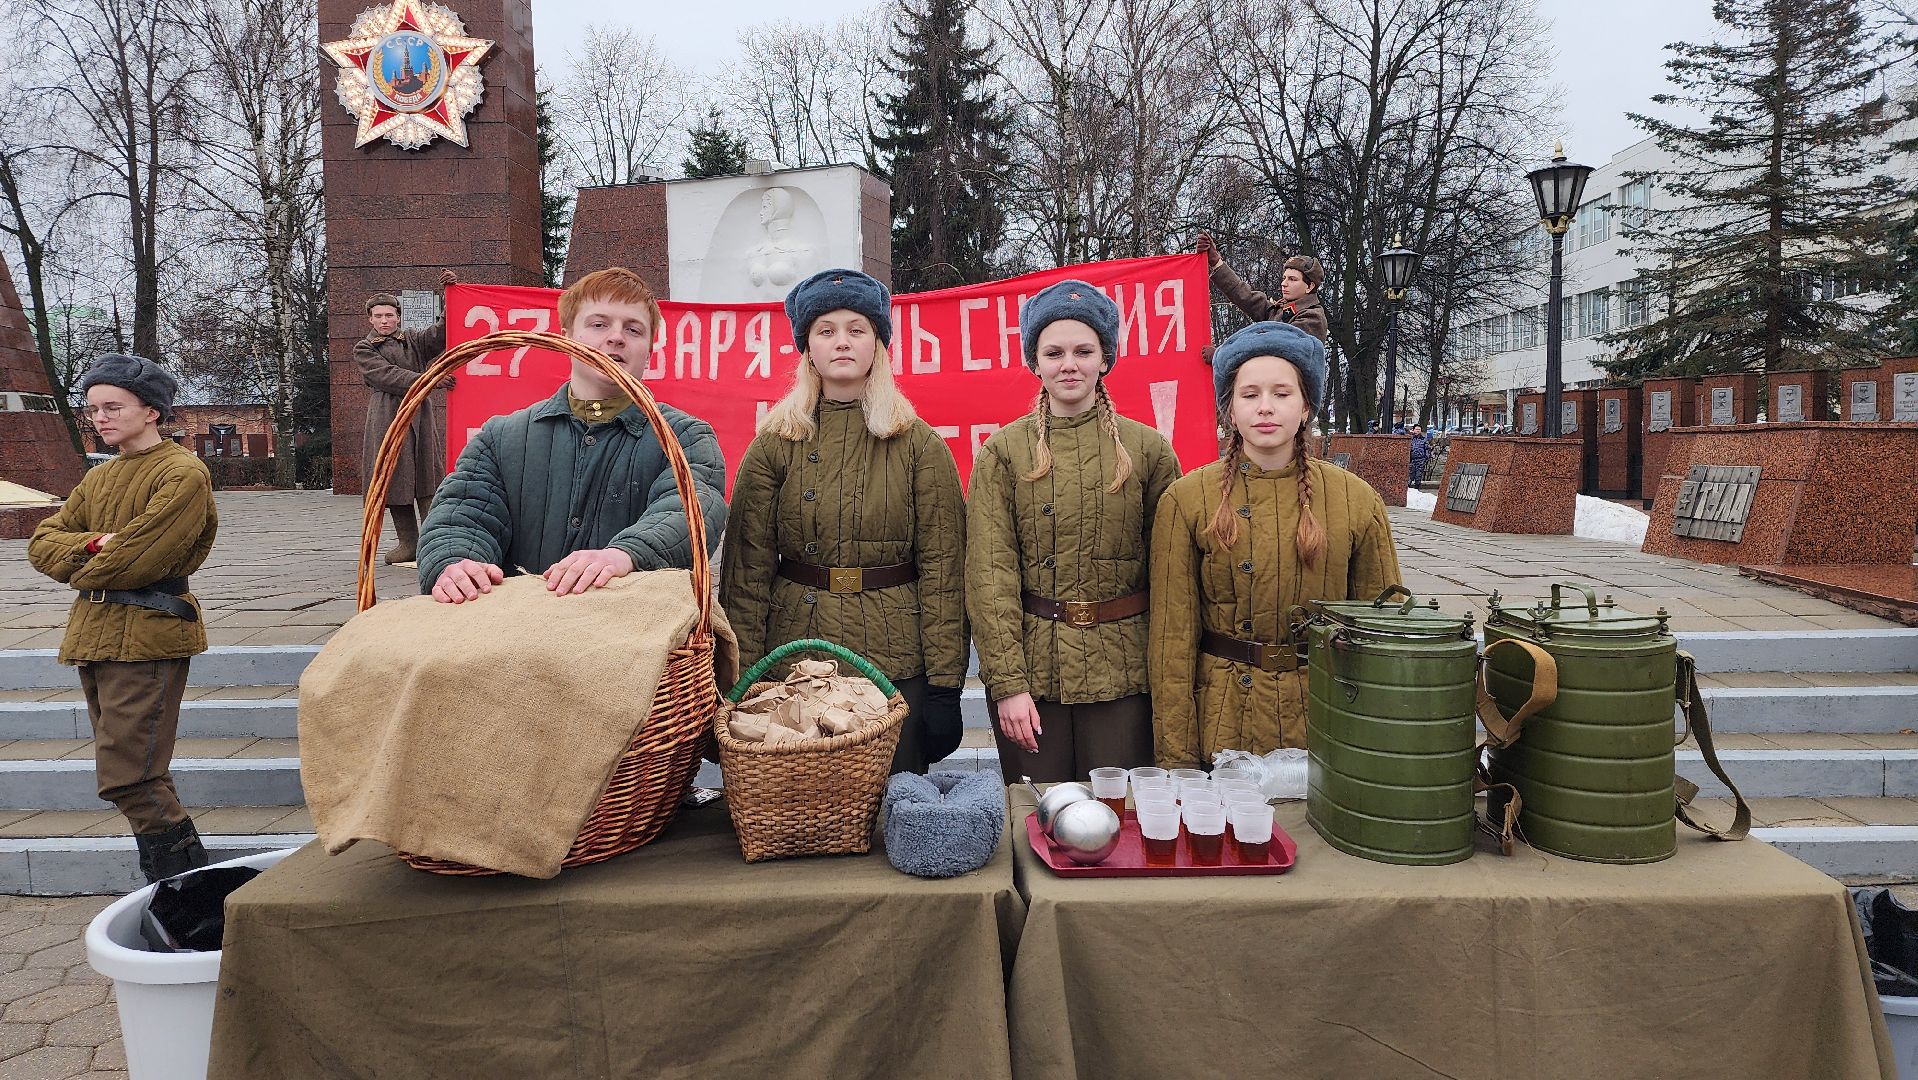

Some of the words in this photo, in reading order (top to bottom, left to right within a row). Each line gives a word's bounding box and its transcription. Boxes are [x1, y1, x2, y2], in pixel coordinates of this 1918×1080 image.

[386, 37, 424, 49] СССР
[464, 305, 550, 378] 27
[960, 279, 1187, 371] СНИЯ
[1694, 481, 1752, 523] ТУЛА
